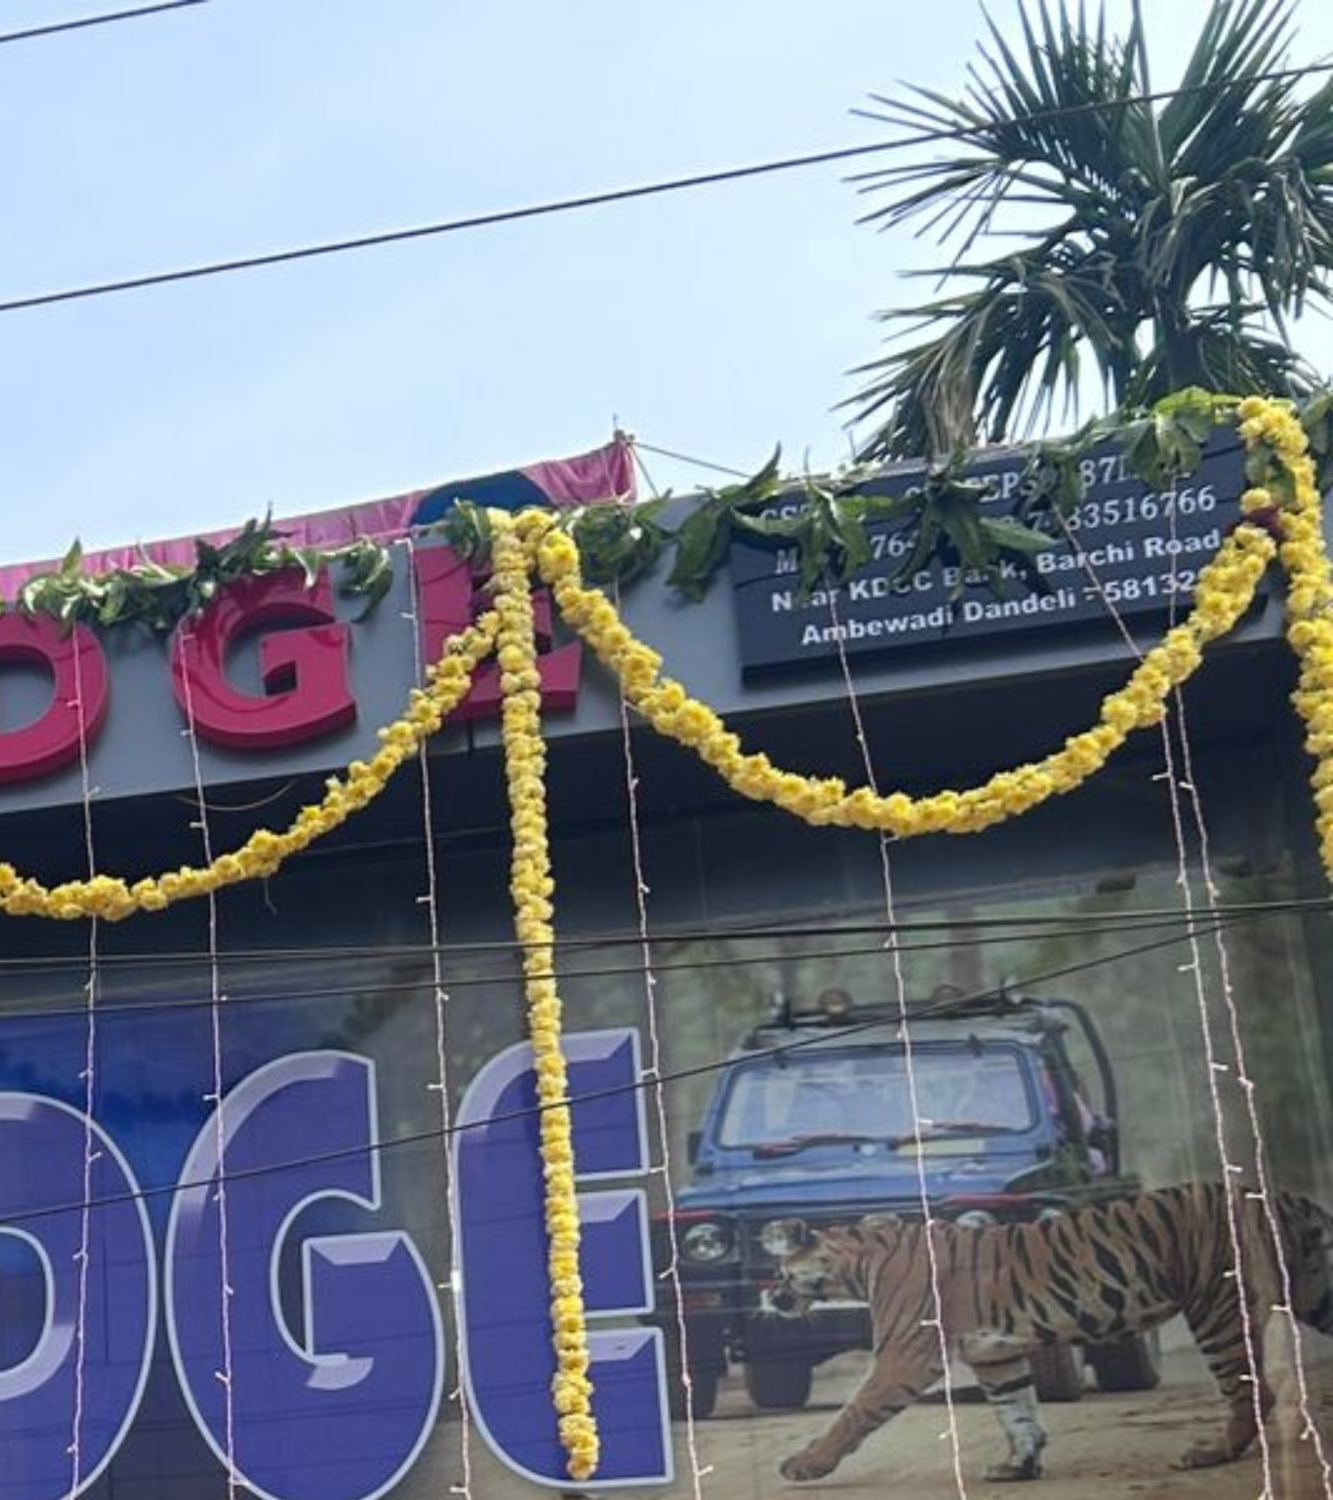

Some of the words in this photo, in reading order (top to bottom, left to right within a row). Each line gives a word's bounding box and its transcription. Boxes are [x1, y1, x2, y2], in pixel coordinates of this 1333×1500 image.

[1030, 485, 1216, 530] 783516766
[771, 585, 838, 612] Nar
[942, 559, 1028, 590] Bak,
[1035, 543, 1135, 574] Barchi
[801, 604, 955, 647] Ambewadi
[963, 589, 1076, 622] Dandeli
[1103, 570, 1207, 602] 58132
